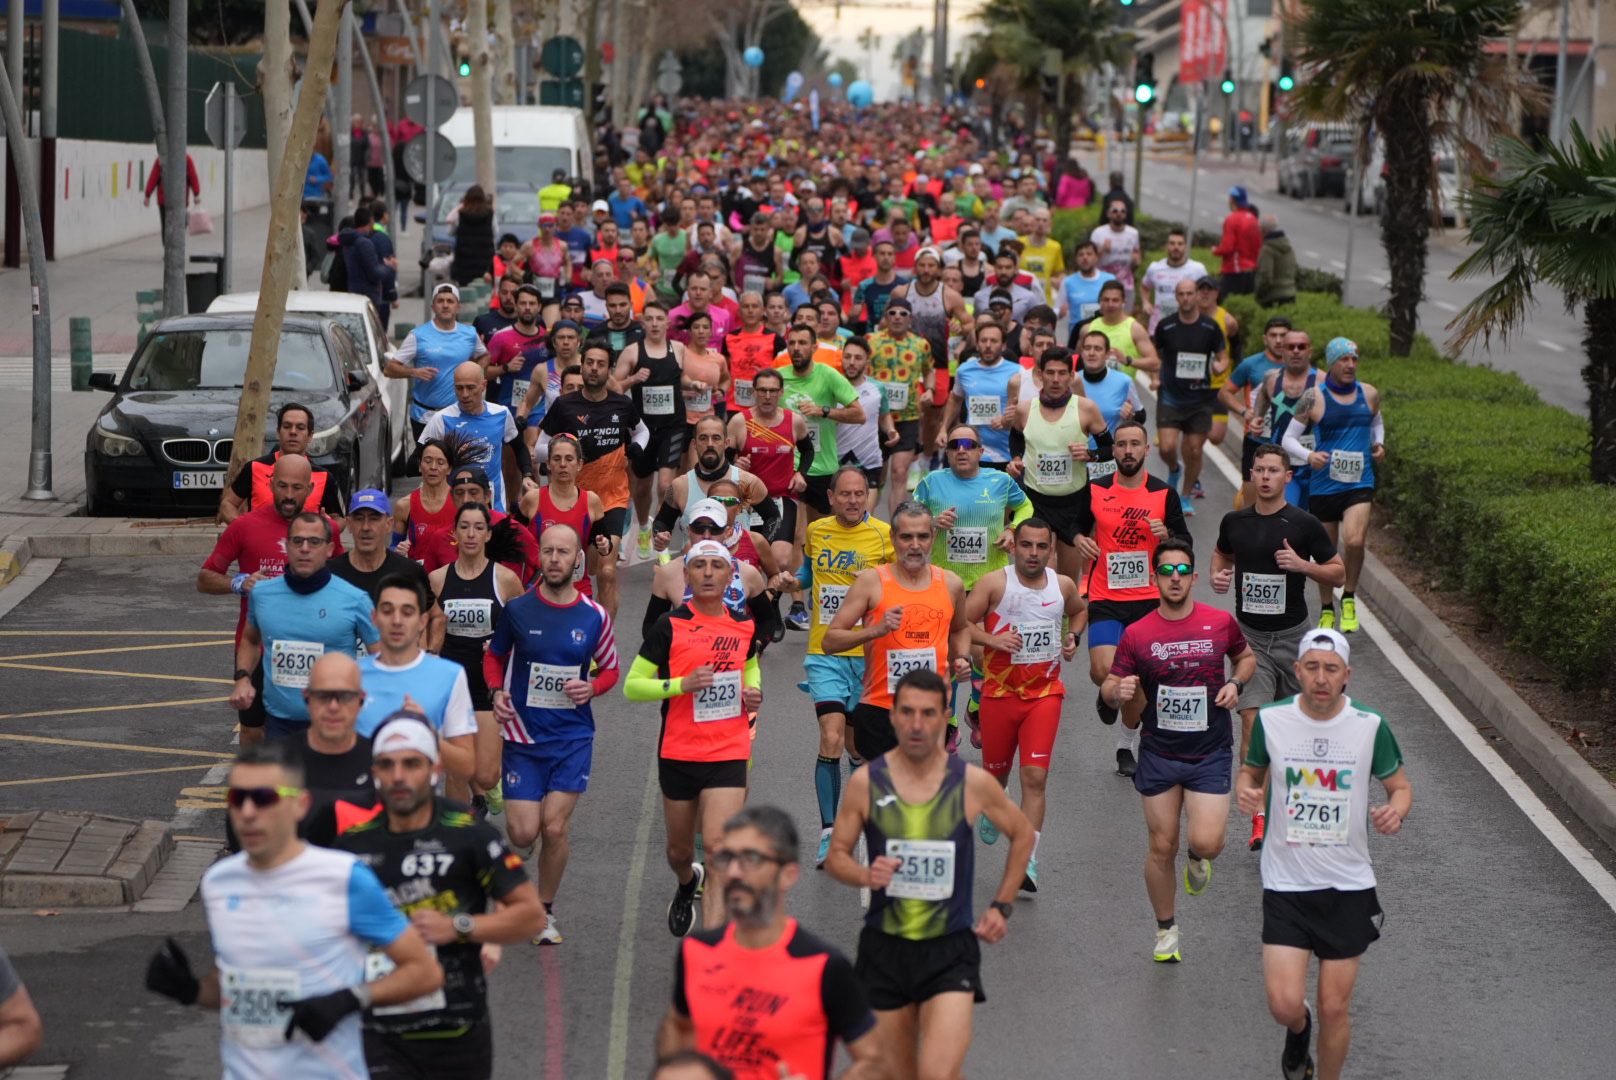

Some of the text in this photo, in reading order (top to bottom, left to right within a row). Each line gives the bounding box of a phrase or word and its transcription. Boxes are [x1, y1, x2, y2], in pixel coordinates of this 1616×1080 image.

[645, 393, 670, 404] 2584
[972, 403, 997, 414] 2956
[1040, 460, 1067, 473] 2821
[1092, 463, 1116, 474] 2899
[1334, 458, 1361, 472] 3015
[182, 473, 217, 487] 6104
[1112, 527, 1142, 539] LIFE
[950, 536, 983, 549] 2644
[1111, 560, 1145, 575] 2796
[1246, 583, 1280, 599] 2567
[449, 609, 485, 624] 2508
[711, 636, 741, 651] RUN
[1018, 631, 1051, 647] 725
[1168, 642, 1213, 651] MEDIO
[276, 653, 316, 669] 2630
[714, 652, 731, 660] FOR
[534, 675, 572, 693] 266
[699, 684, 736, 703] 2523
[1161, 697, 1201, 715] 2547
[1169, 713, 1194, 721] MIGUEL
[1294, 802, 1341, 824] 2761
[1304, 822, 1331, 831] COLAU
[401, 853, 454, 877] 637
[894, 857, 945, 877] 2518
